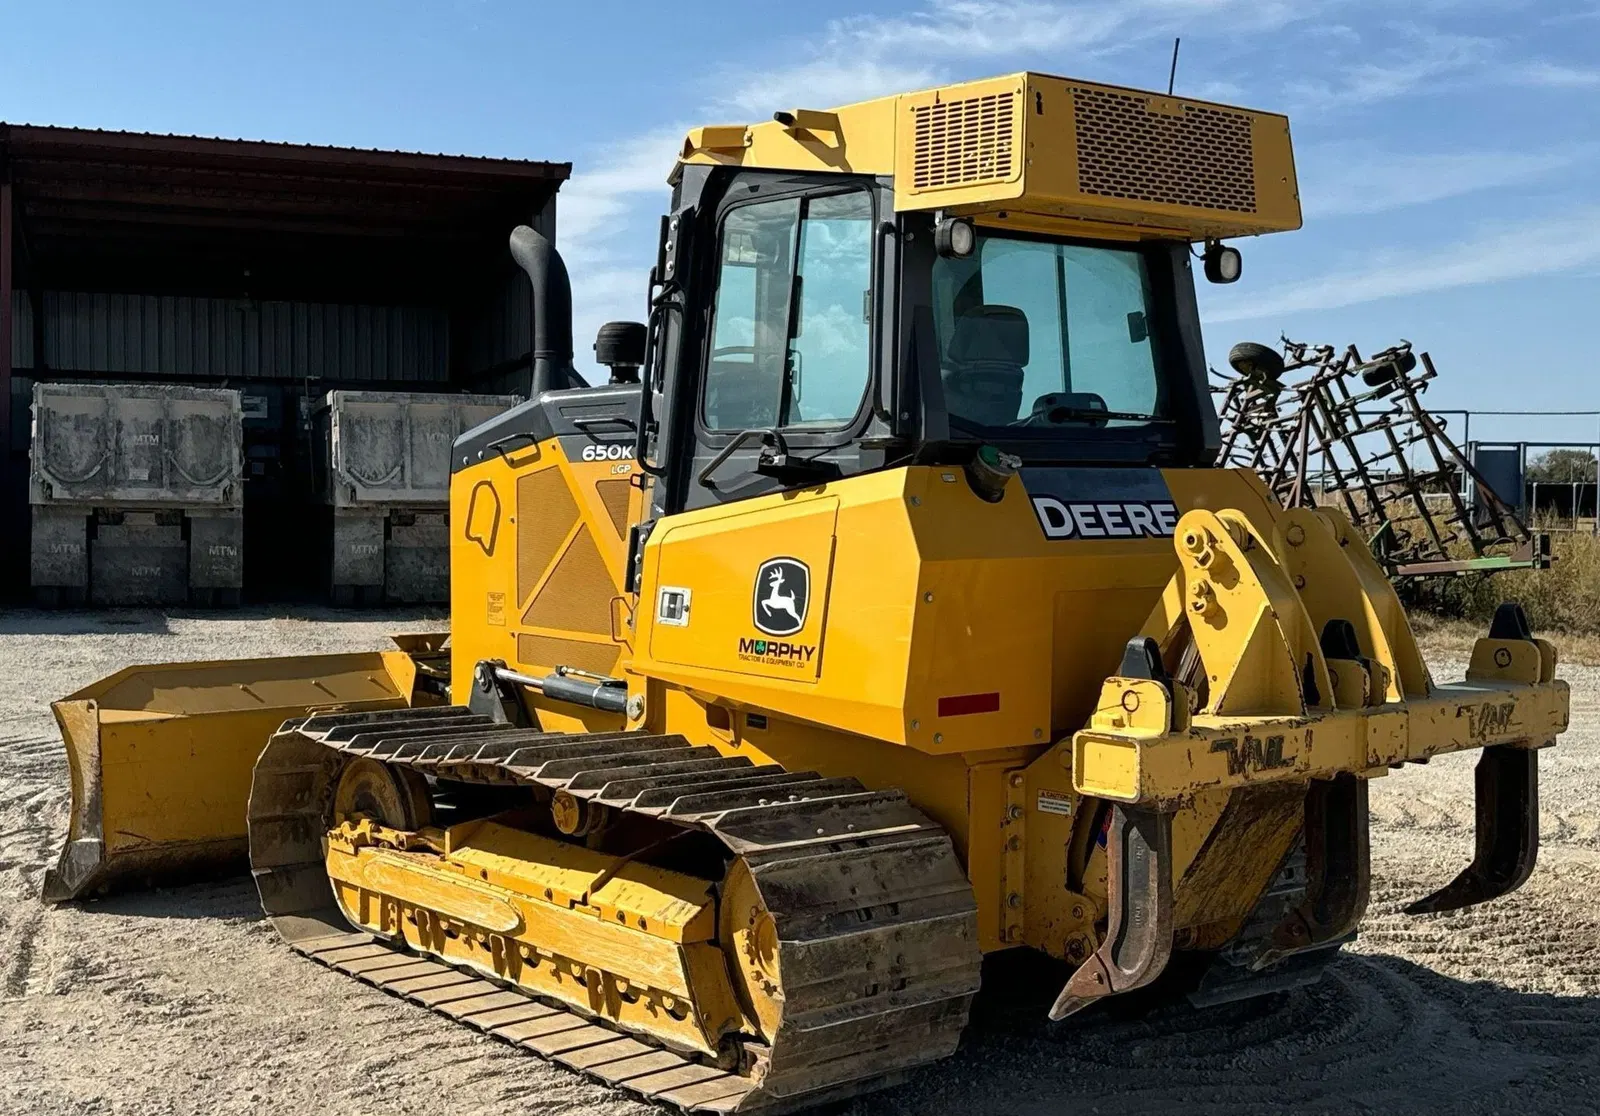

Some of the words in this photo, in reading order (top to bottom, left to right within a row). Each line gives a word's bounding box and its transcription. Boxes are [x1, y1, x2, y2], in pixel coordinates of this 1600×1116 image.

[133, 434, 159, 446] MTM
[582, 444, 634, 462] 650K
[611, 464, 632, 475] LGP
[1032, 497, 1178, 537] DEERE
[50, 543, 81, 554] MTM
[208, 544, 238, 557] MTM
[351, 544, 379, 555] MTM
[739, 637, 816, 661] MURPHY
